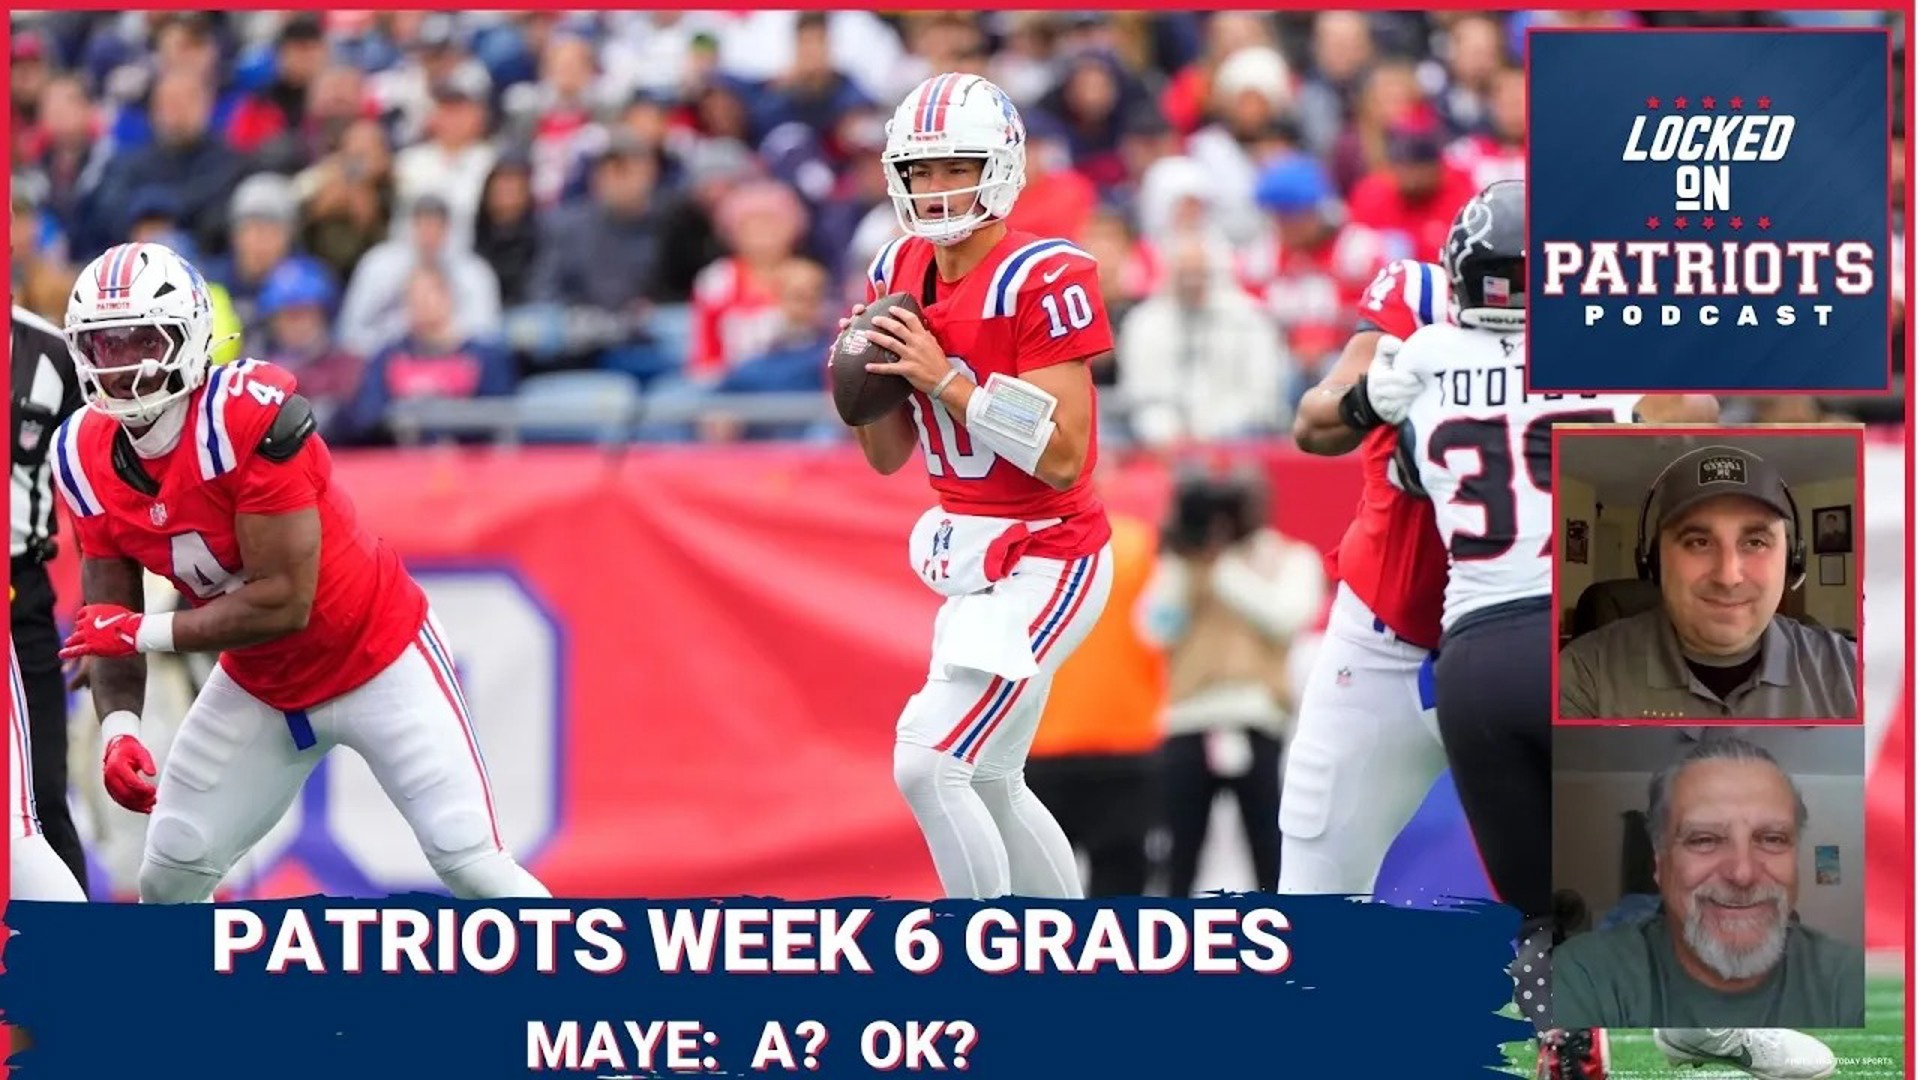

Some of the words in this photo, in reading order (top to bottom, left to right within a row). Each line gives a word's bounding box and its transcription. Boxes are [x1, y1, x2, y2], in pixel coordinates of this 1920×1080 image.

[1041, 283, 1094, 340] 10
[246, 379, 285, 406] 4
[170, 530, 250, 599] 4
